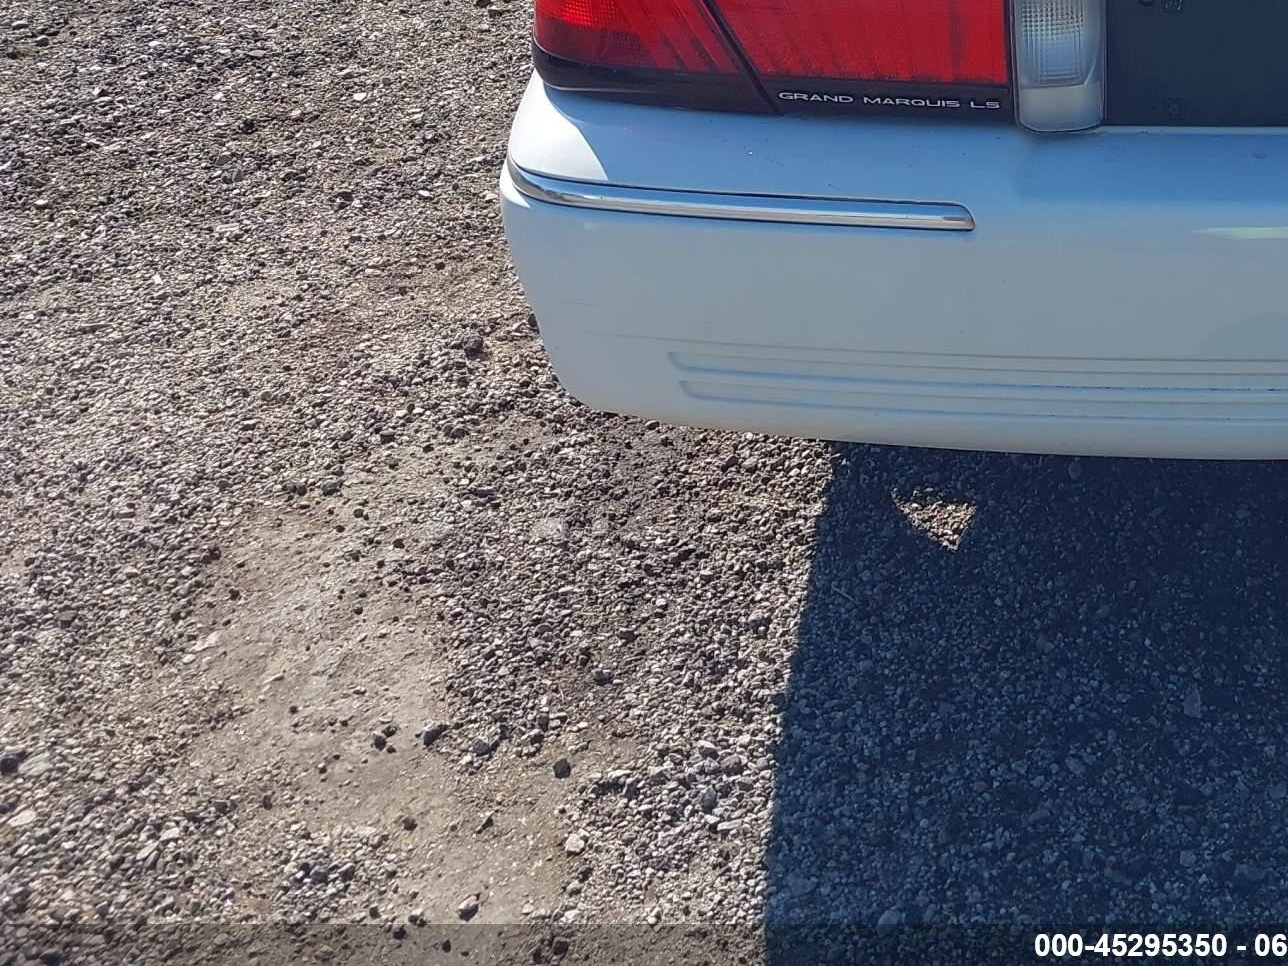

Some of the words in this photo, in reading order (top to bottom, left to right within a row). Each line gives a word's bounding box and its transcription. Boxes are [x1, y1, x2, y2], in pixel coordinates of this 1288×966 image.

[778, 92, 854, 103] GRAND
[863, 97, 961, 108] MARQUIS
[970, 100, 1001, 109] LS
